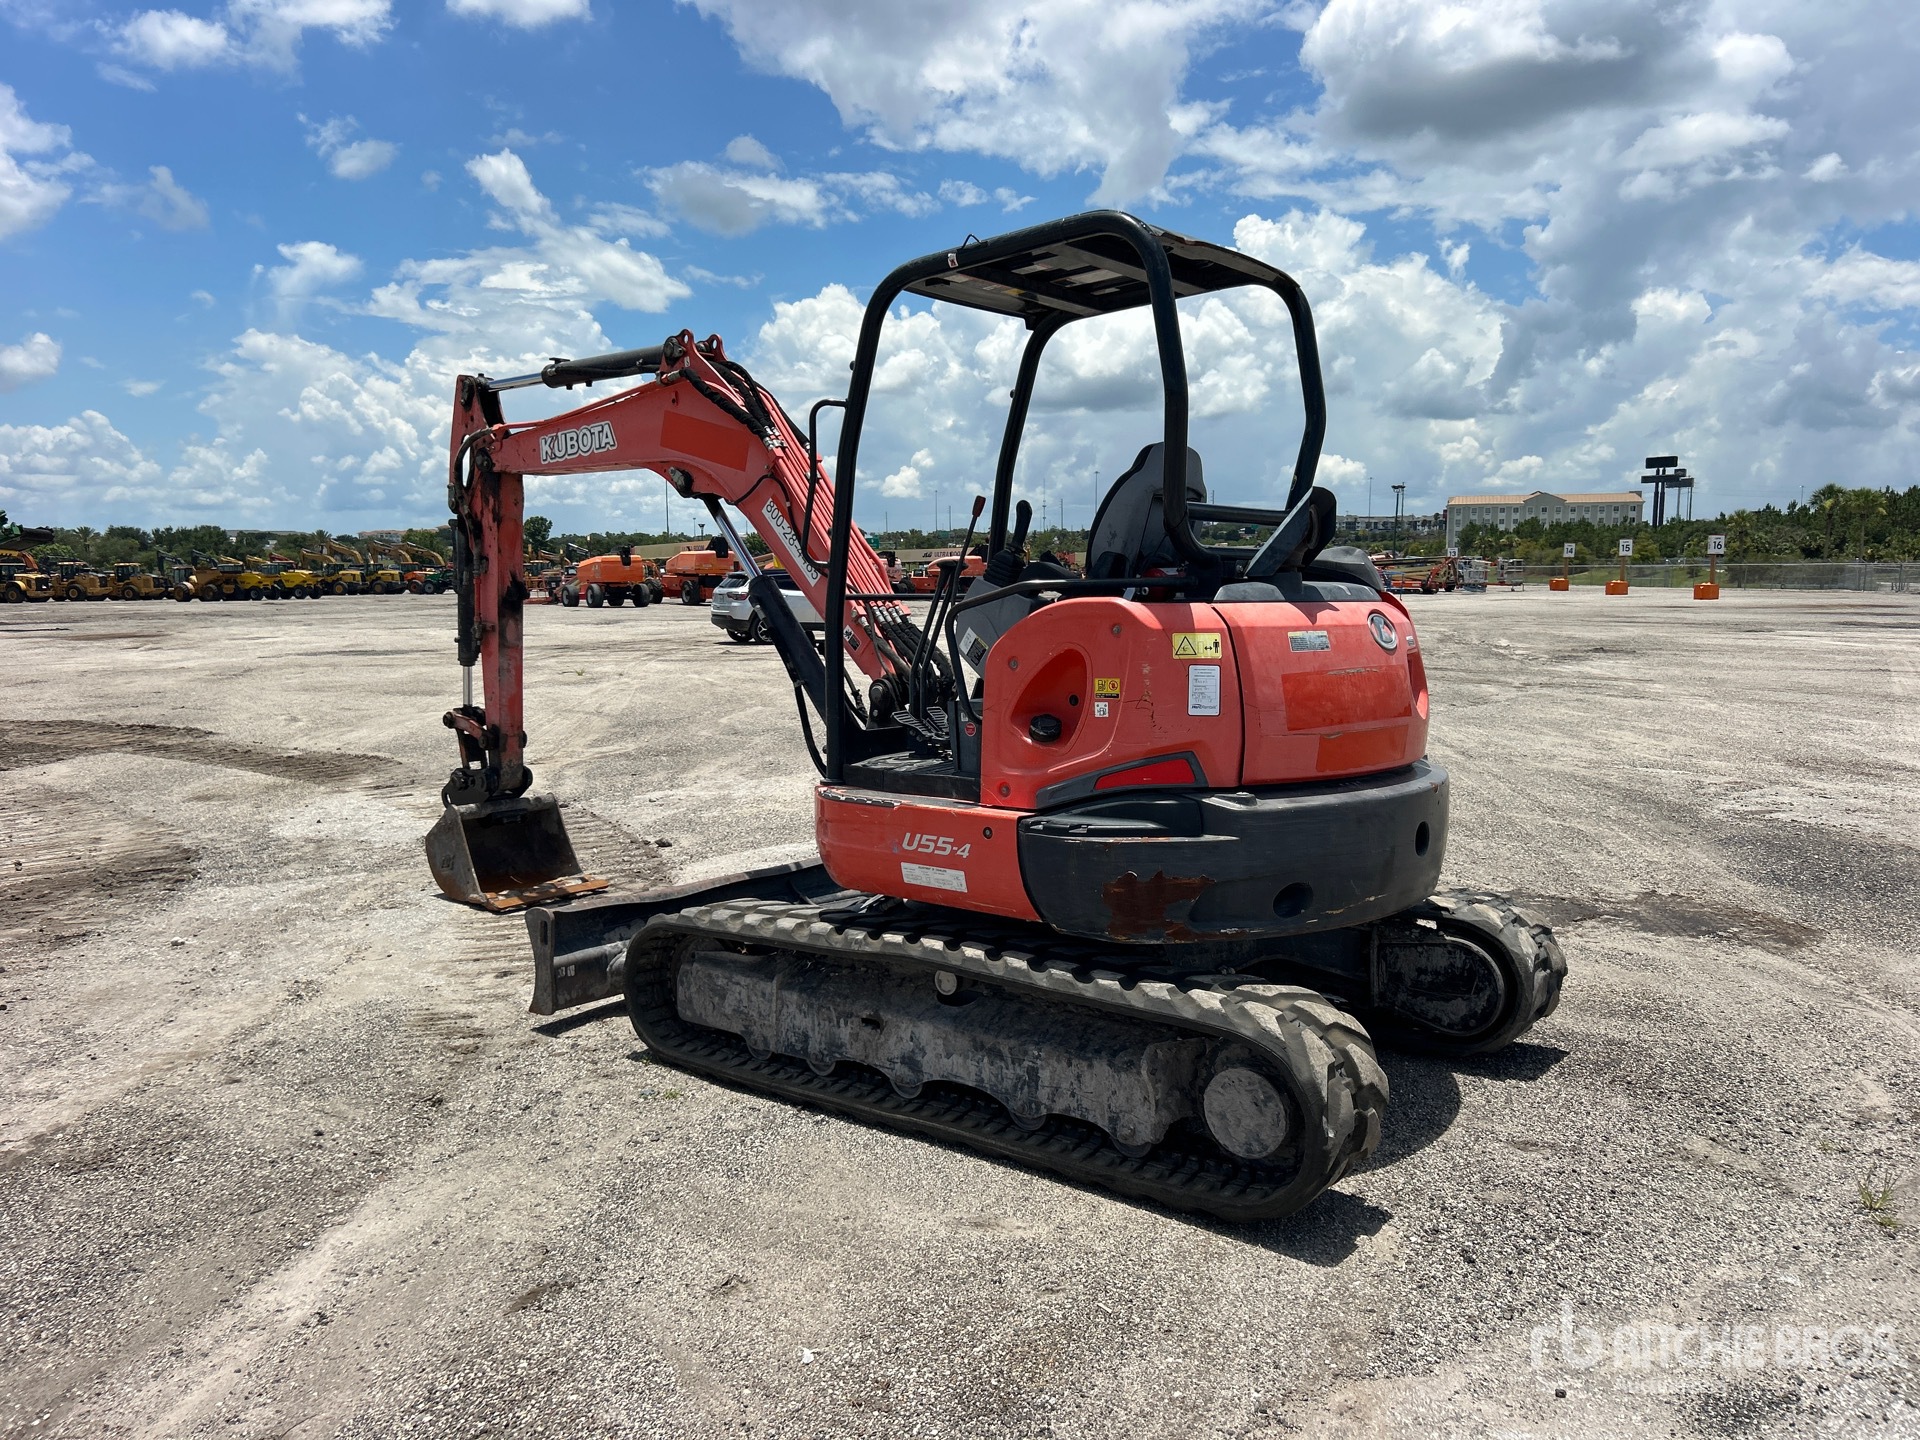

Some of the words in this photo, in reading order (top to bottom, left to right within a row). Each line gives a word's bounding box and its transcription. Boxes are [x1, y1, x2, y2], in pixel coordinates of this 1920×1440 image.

[541, 422, 616, 462] KUBOTA
[1621, 544, 1631, 552] 15
[1713, 541, 1722, 550] 16
[1565, 547, 1574, 555] 14
[902, 832, 971, 858] U55-4
